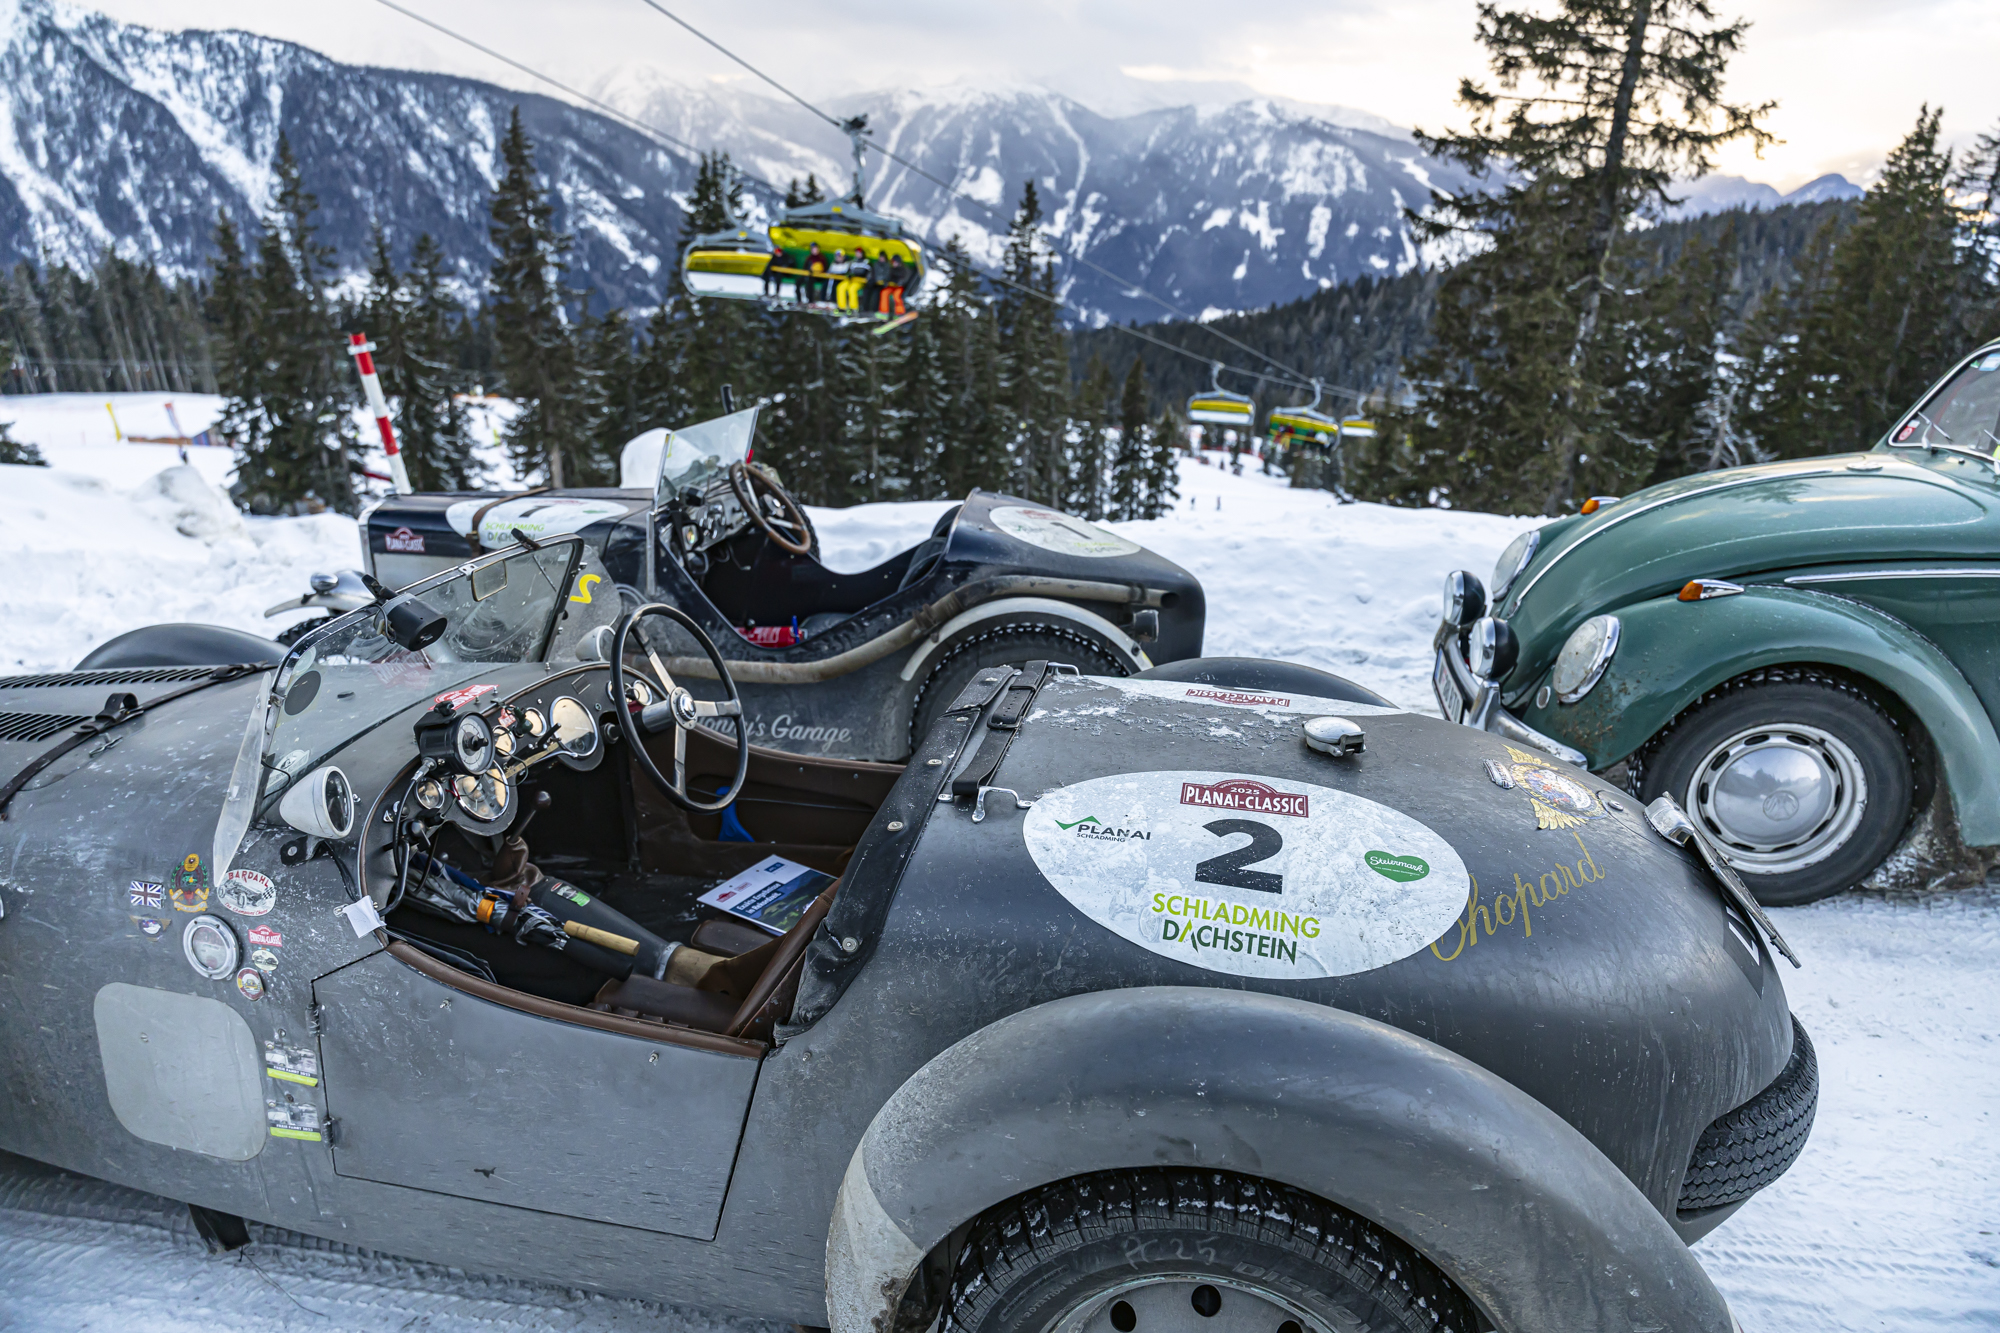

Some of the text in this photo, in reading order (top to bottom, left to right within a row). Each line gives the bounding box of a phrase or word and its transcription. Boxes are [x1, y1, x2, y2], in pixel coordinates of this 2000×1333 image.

[1189, 689, 1287, 706] PLANAI-CLASSIC
[771, 714, 851, 752] Garage
[1185, 786, 1304, 815] PLANAI-CLASSIC
[1230, 787, 1260, 795] 2025
[1076, 833, 1126, 843] SCHLADMING
[1077, 824, 1151, 841] PLANAI
[1194, 818, 1283, 895] 2
[1369, 856, 1425, 874] Steiermark
[228, 871, 269, 888] BARDAHL
[1151, 893, 1321, 939] SCHLADMING
[1162, 919, 1298, 966] DACHSTEIN
[1169, 1235, 1220, 1266] 25
[1024, 1284, 1068, 1318] ROTATION
